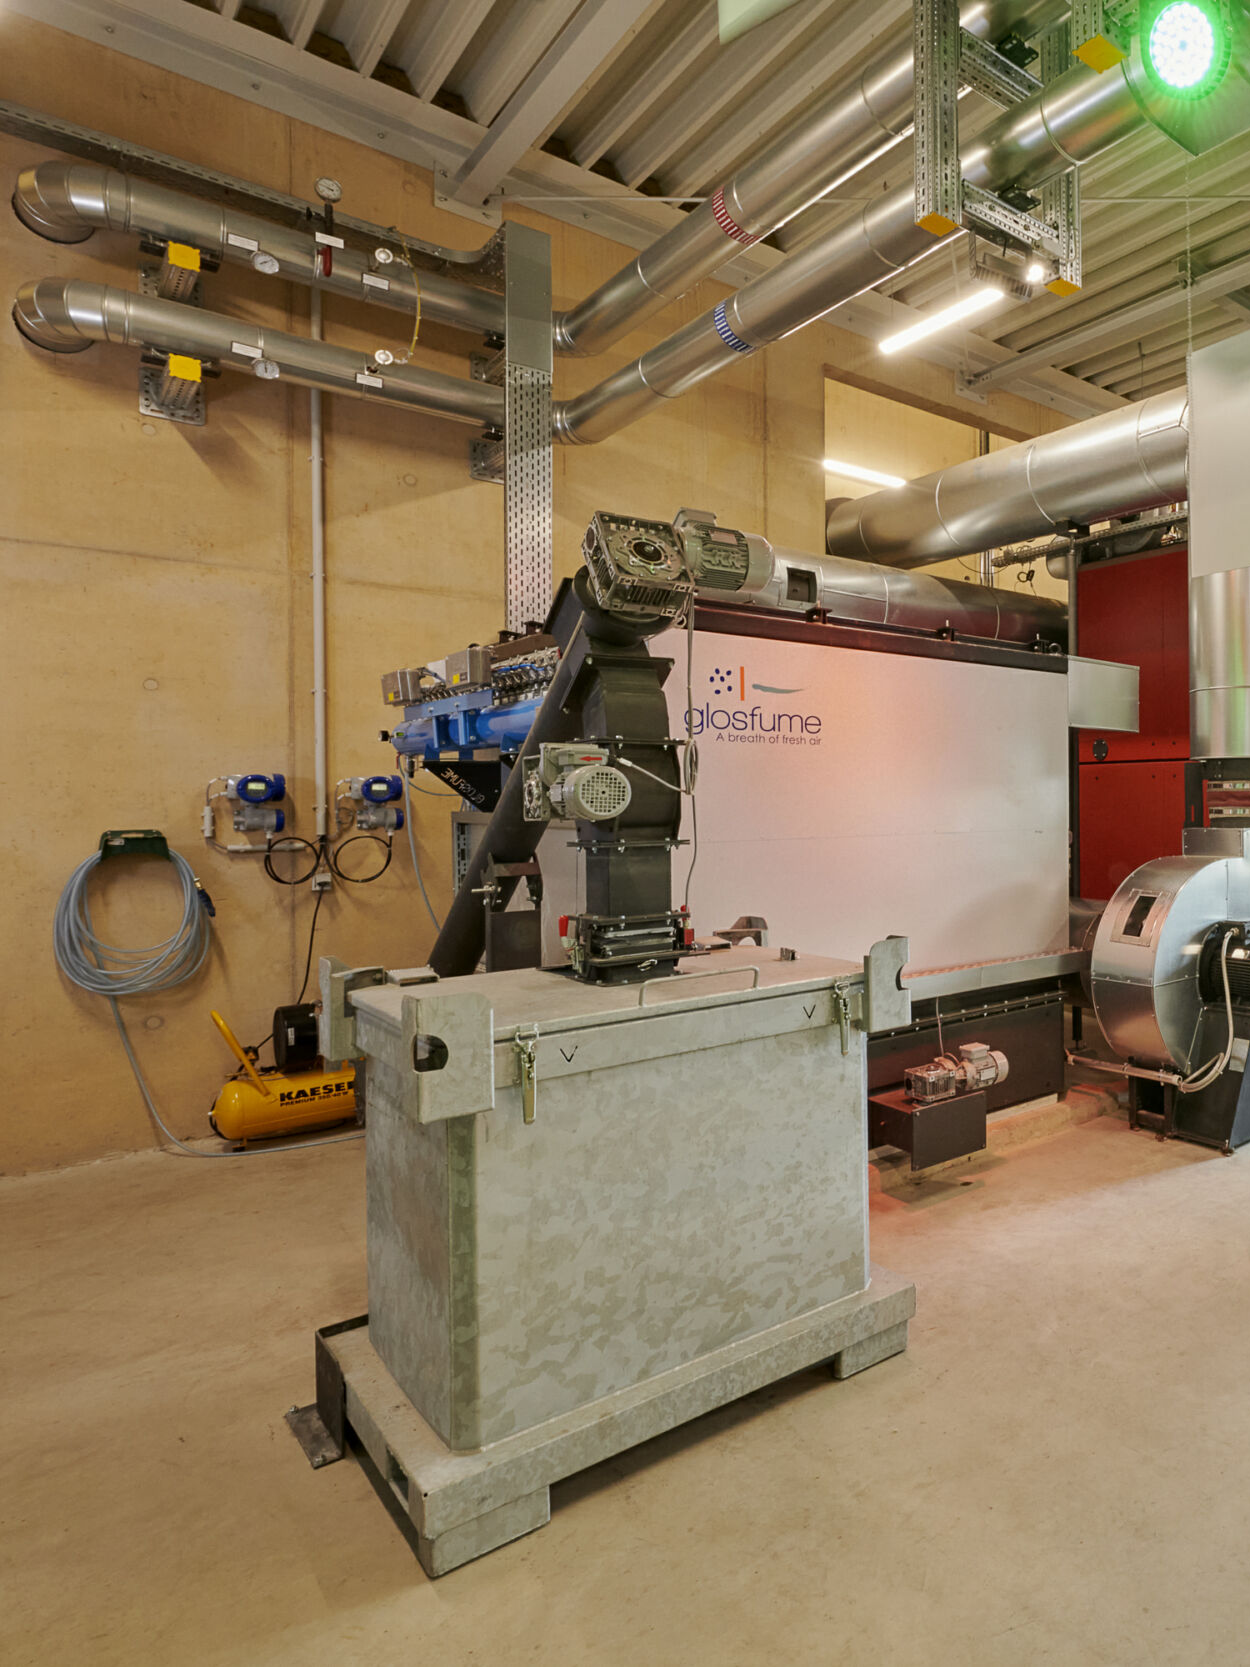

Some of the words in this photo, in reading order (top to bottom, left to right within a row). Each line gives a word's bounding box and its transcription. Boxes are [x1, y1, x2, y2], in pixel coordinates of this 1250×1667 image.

[684, 702, 822, 735] glosfume
[715, 732, 725, 743] A
[728, 732, 766, 744] breath
[768, 733, 781, 745] of
[782, 734, 807, 745] fresh
[809, 736, 822, 746] air
[280, 1097, 316, 1107] PREMIUM
